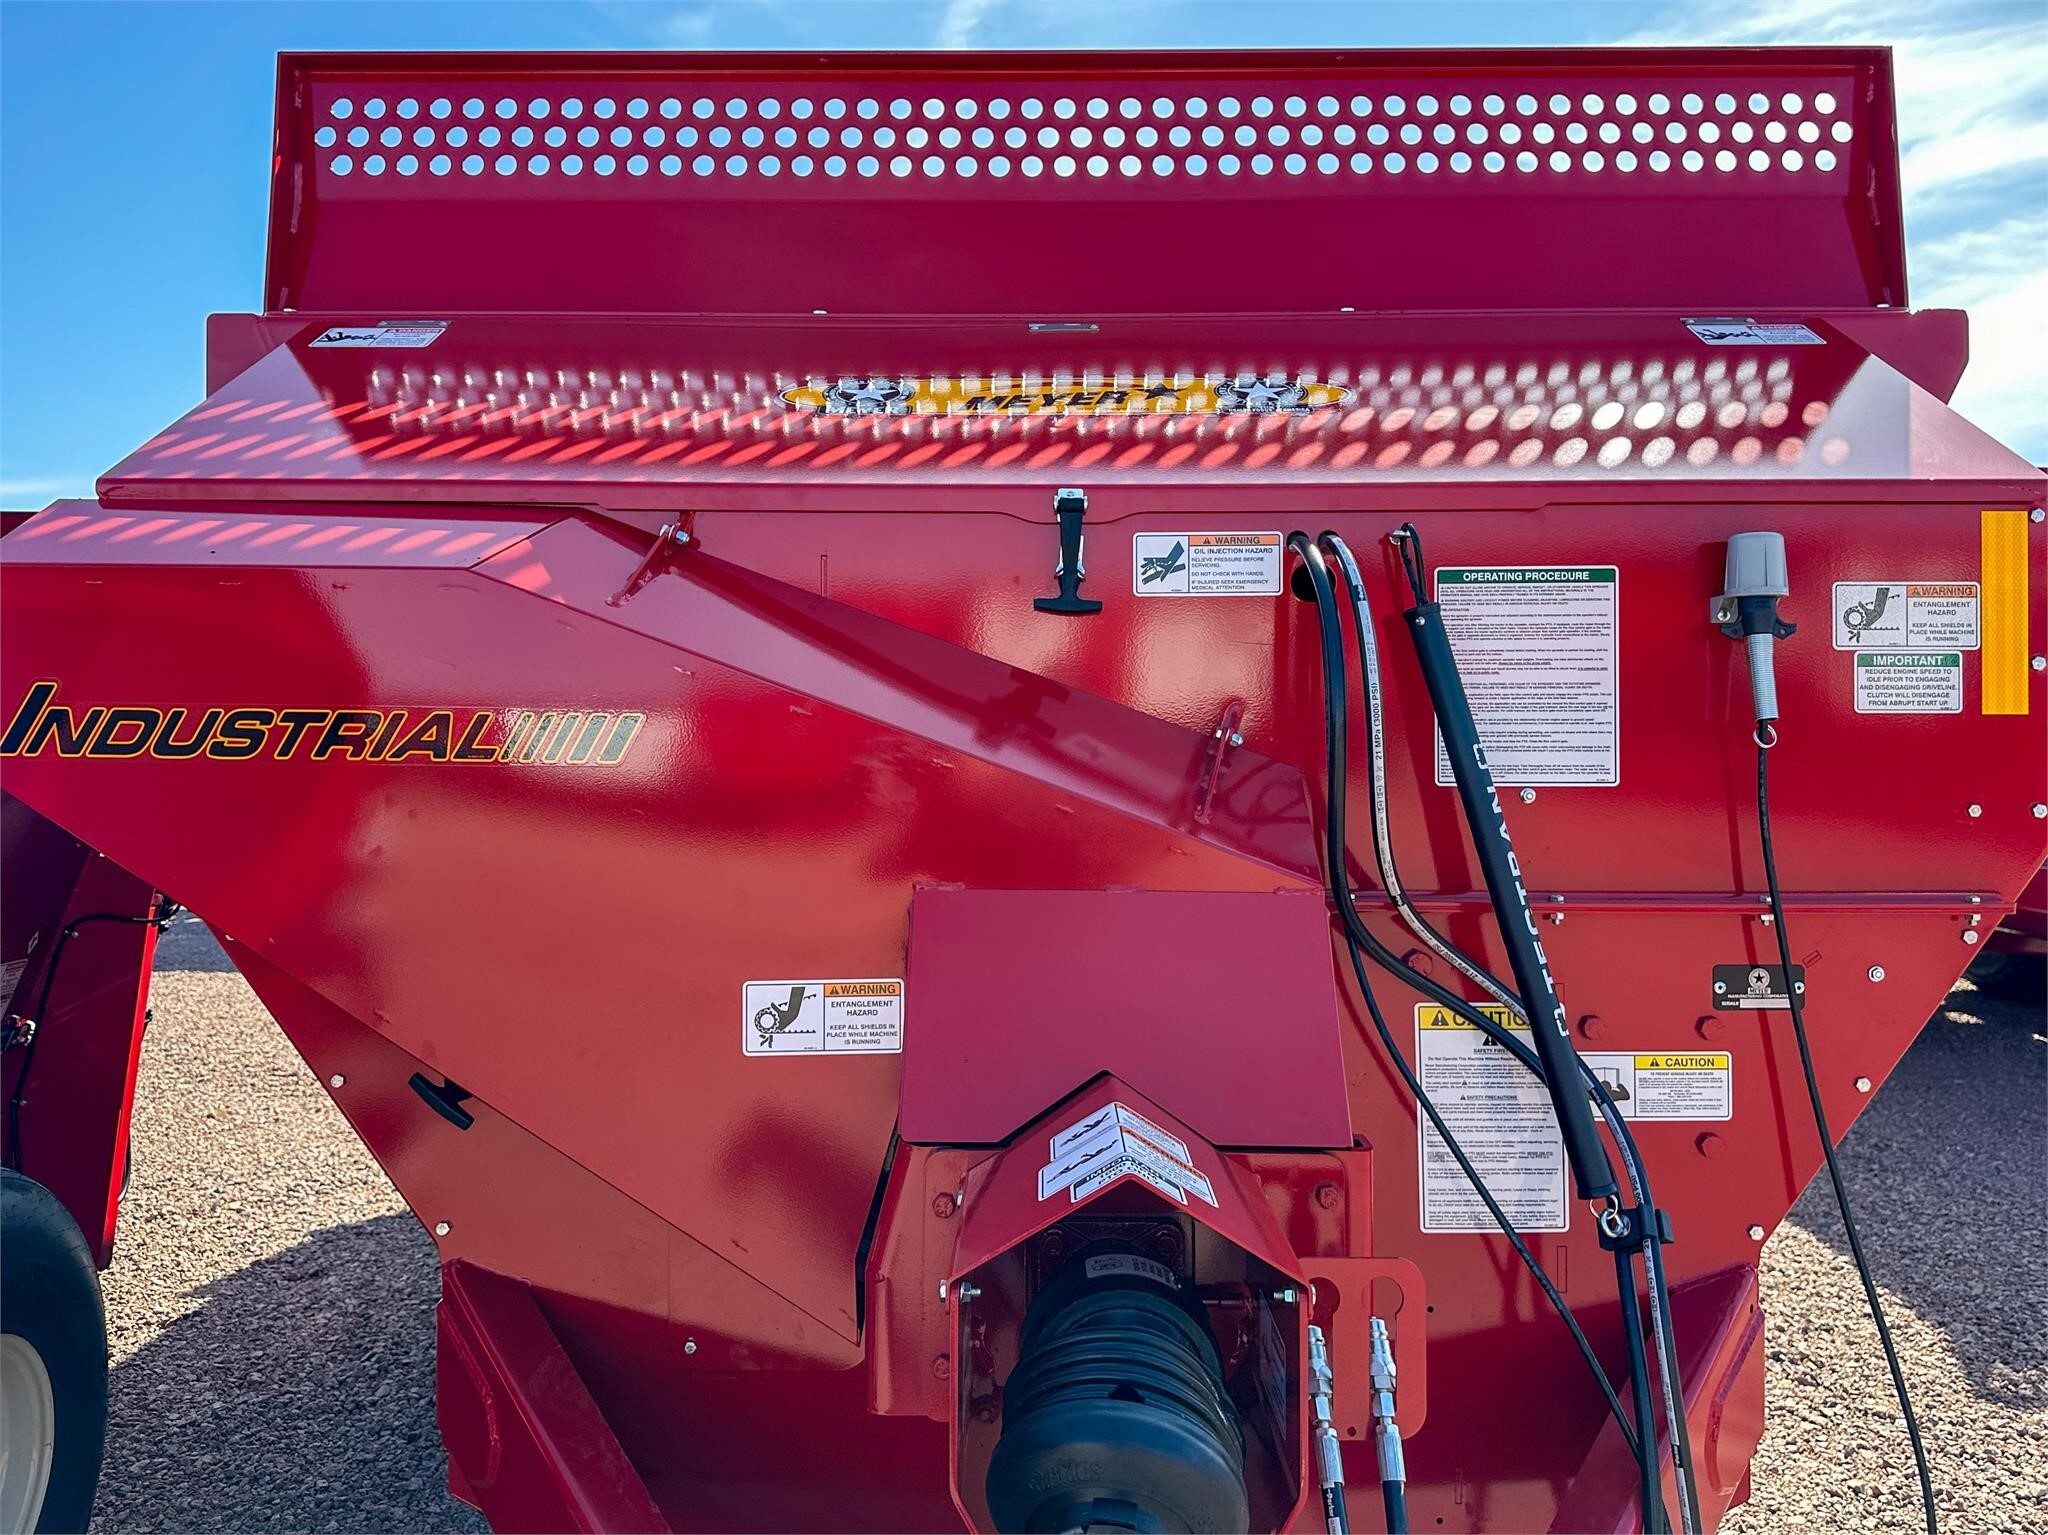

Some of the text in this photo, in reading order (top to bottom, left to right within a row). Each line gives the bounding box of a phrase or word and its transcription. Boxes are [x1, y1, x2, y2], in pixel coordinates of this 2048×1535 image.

[959, 391, 1129, 410] MEYER
[1215, 536, 1260, 544] WARNING
[1463, 571, 1589, 581] OPERATING PROCEDURE
[1923, 587, 1972, 595] WARNING
[1873, 656, 1942, 665] IMPORTANT
[1371, 682, 1379, 701] PSI)
[1373, 702, 1381, 727] (3000
[0, 682, 503, 761] INDUSTRIAL
[1374, 728, 1382, 748] MPa
[1375, 750, 1382, 760] 21
[841, 984, 896, 994] WARNING
[831, 1000, 893, 1008] ENTANGLEMENT
[1665, 1058, 1714, 1067] CAUTION
